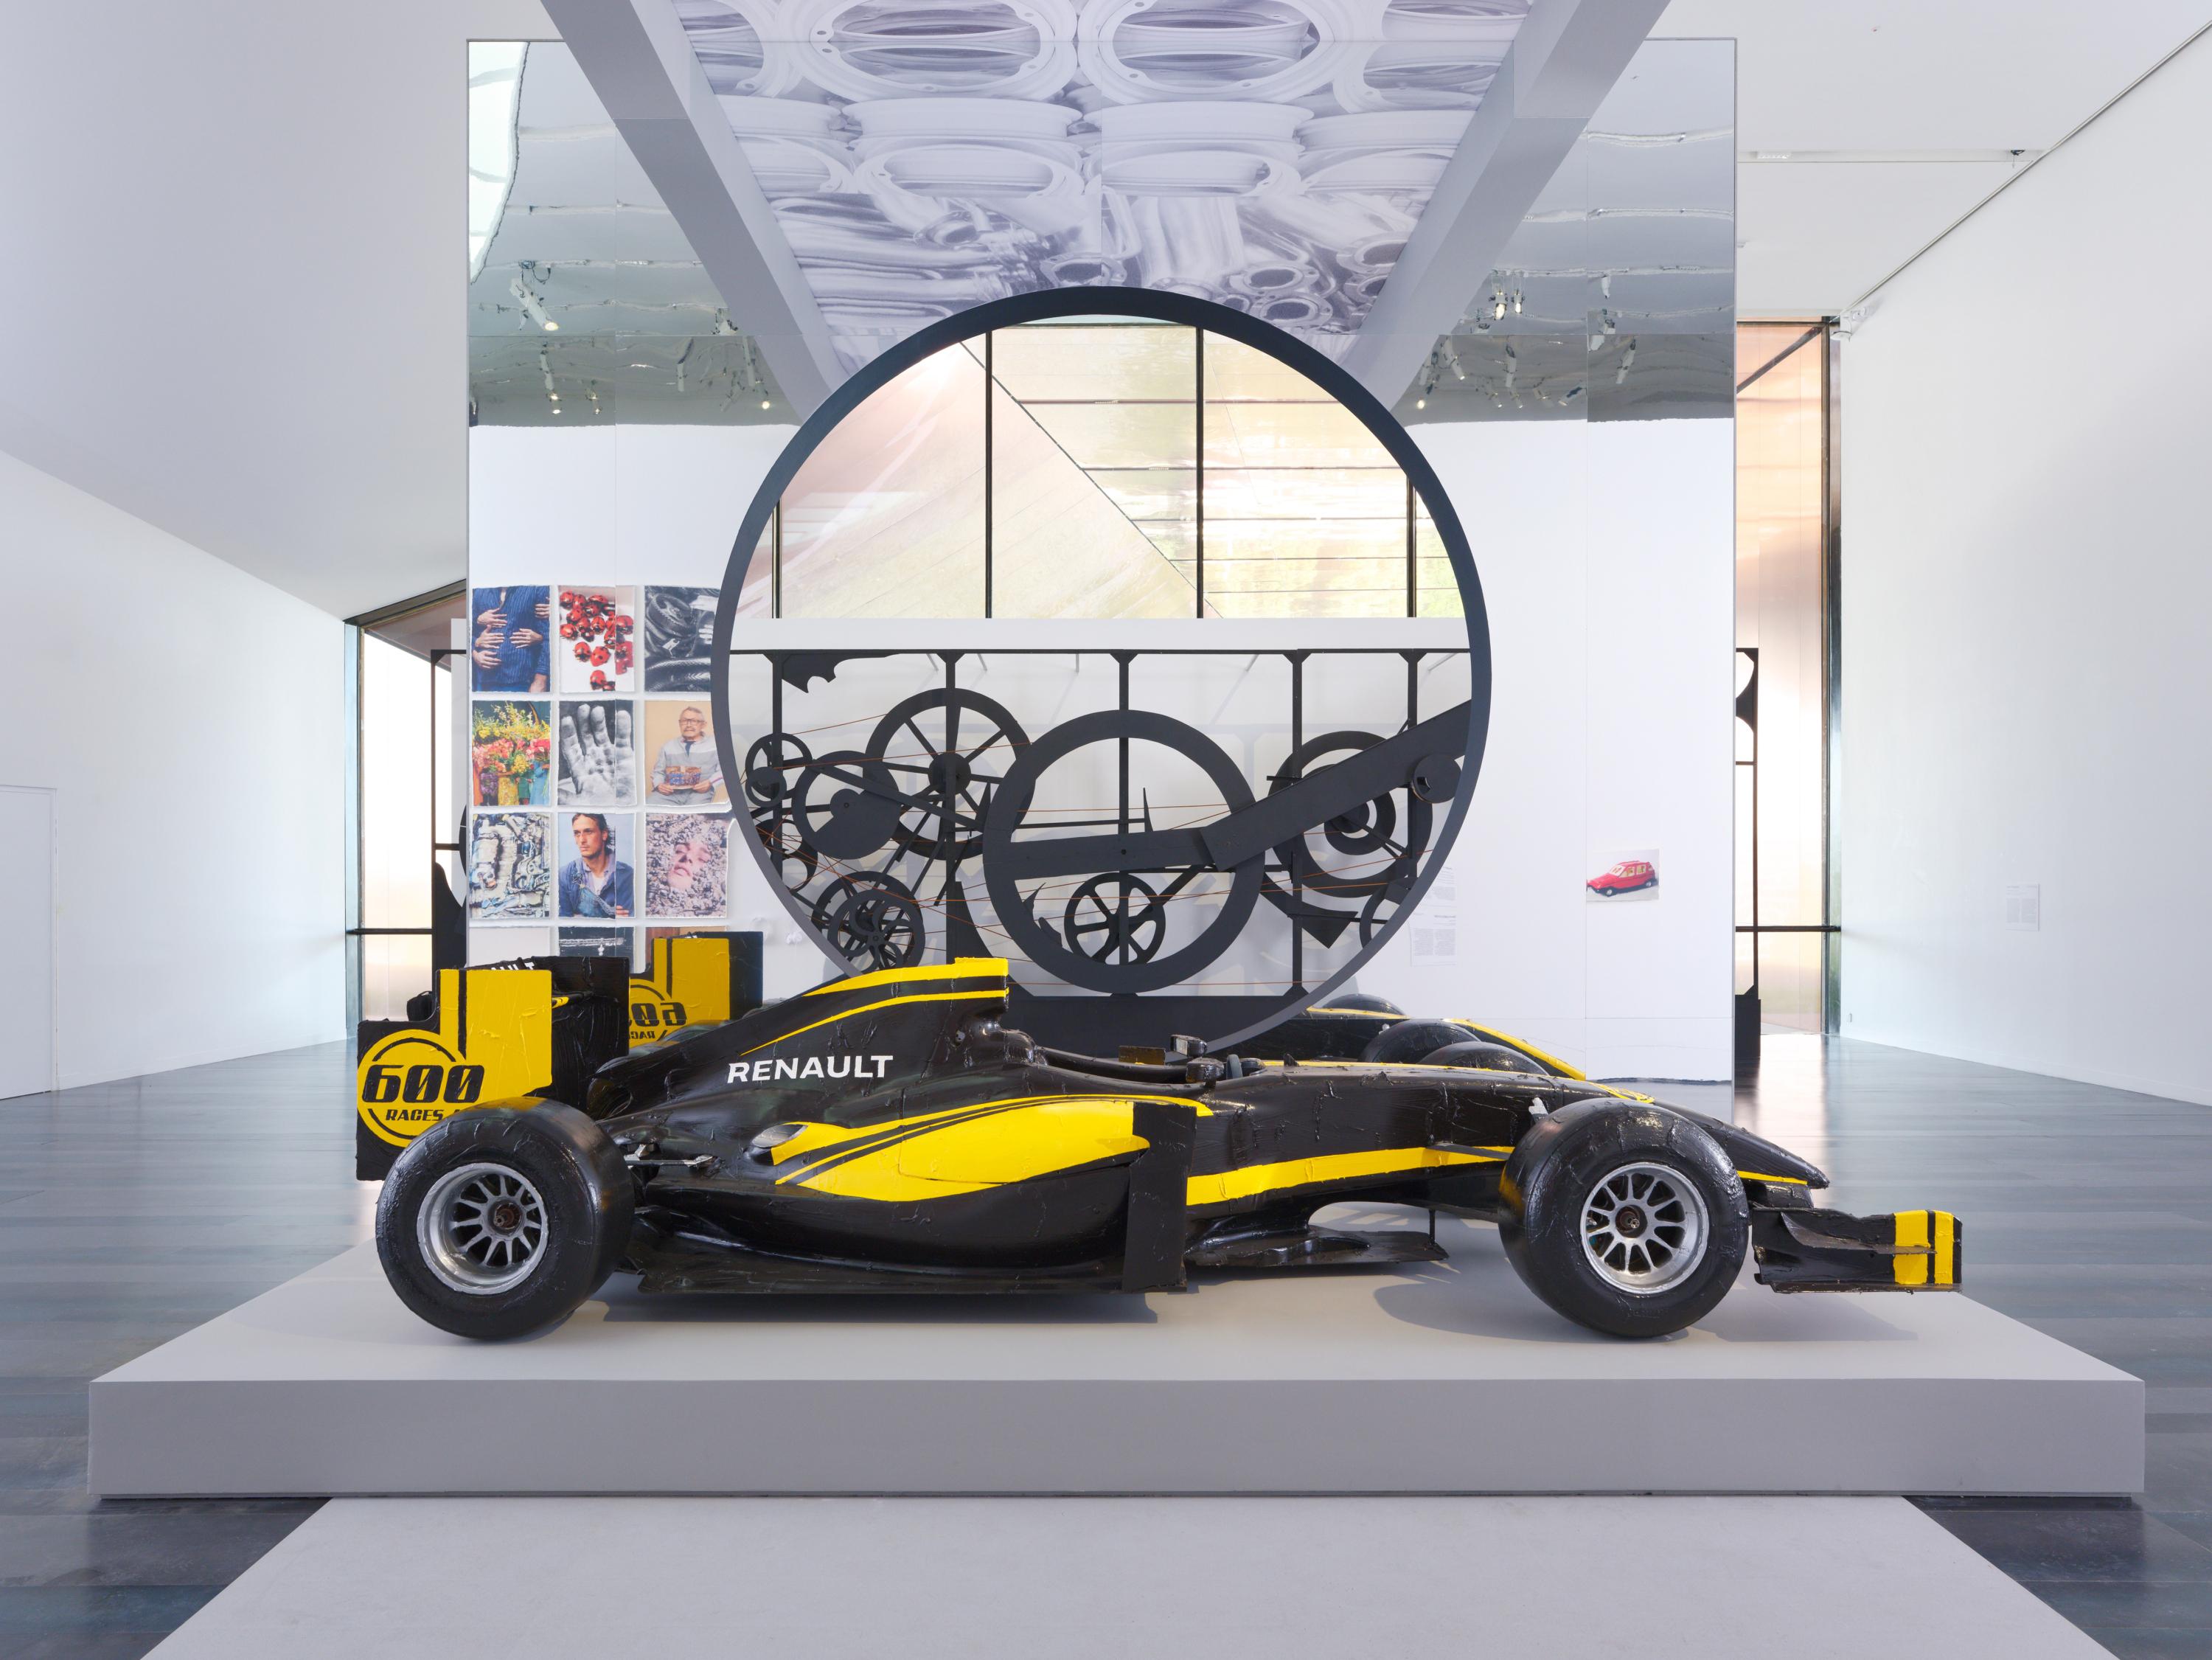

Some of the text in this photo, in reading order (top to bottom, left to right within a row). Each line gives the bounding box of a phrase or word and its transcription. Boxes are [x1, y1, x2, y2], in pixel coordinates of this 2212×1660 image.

[727, 1055, 894, 1083] RENAULT
[361, 1064, 485, 1103] 600
[386, 1108, 444, 1122] RACES
